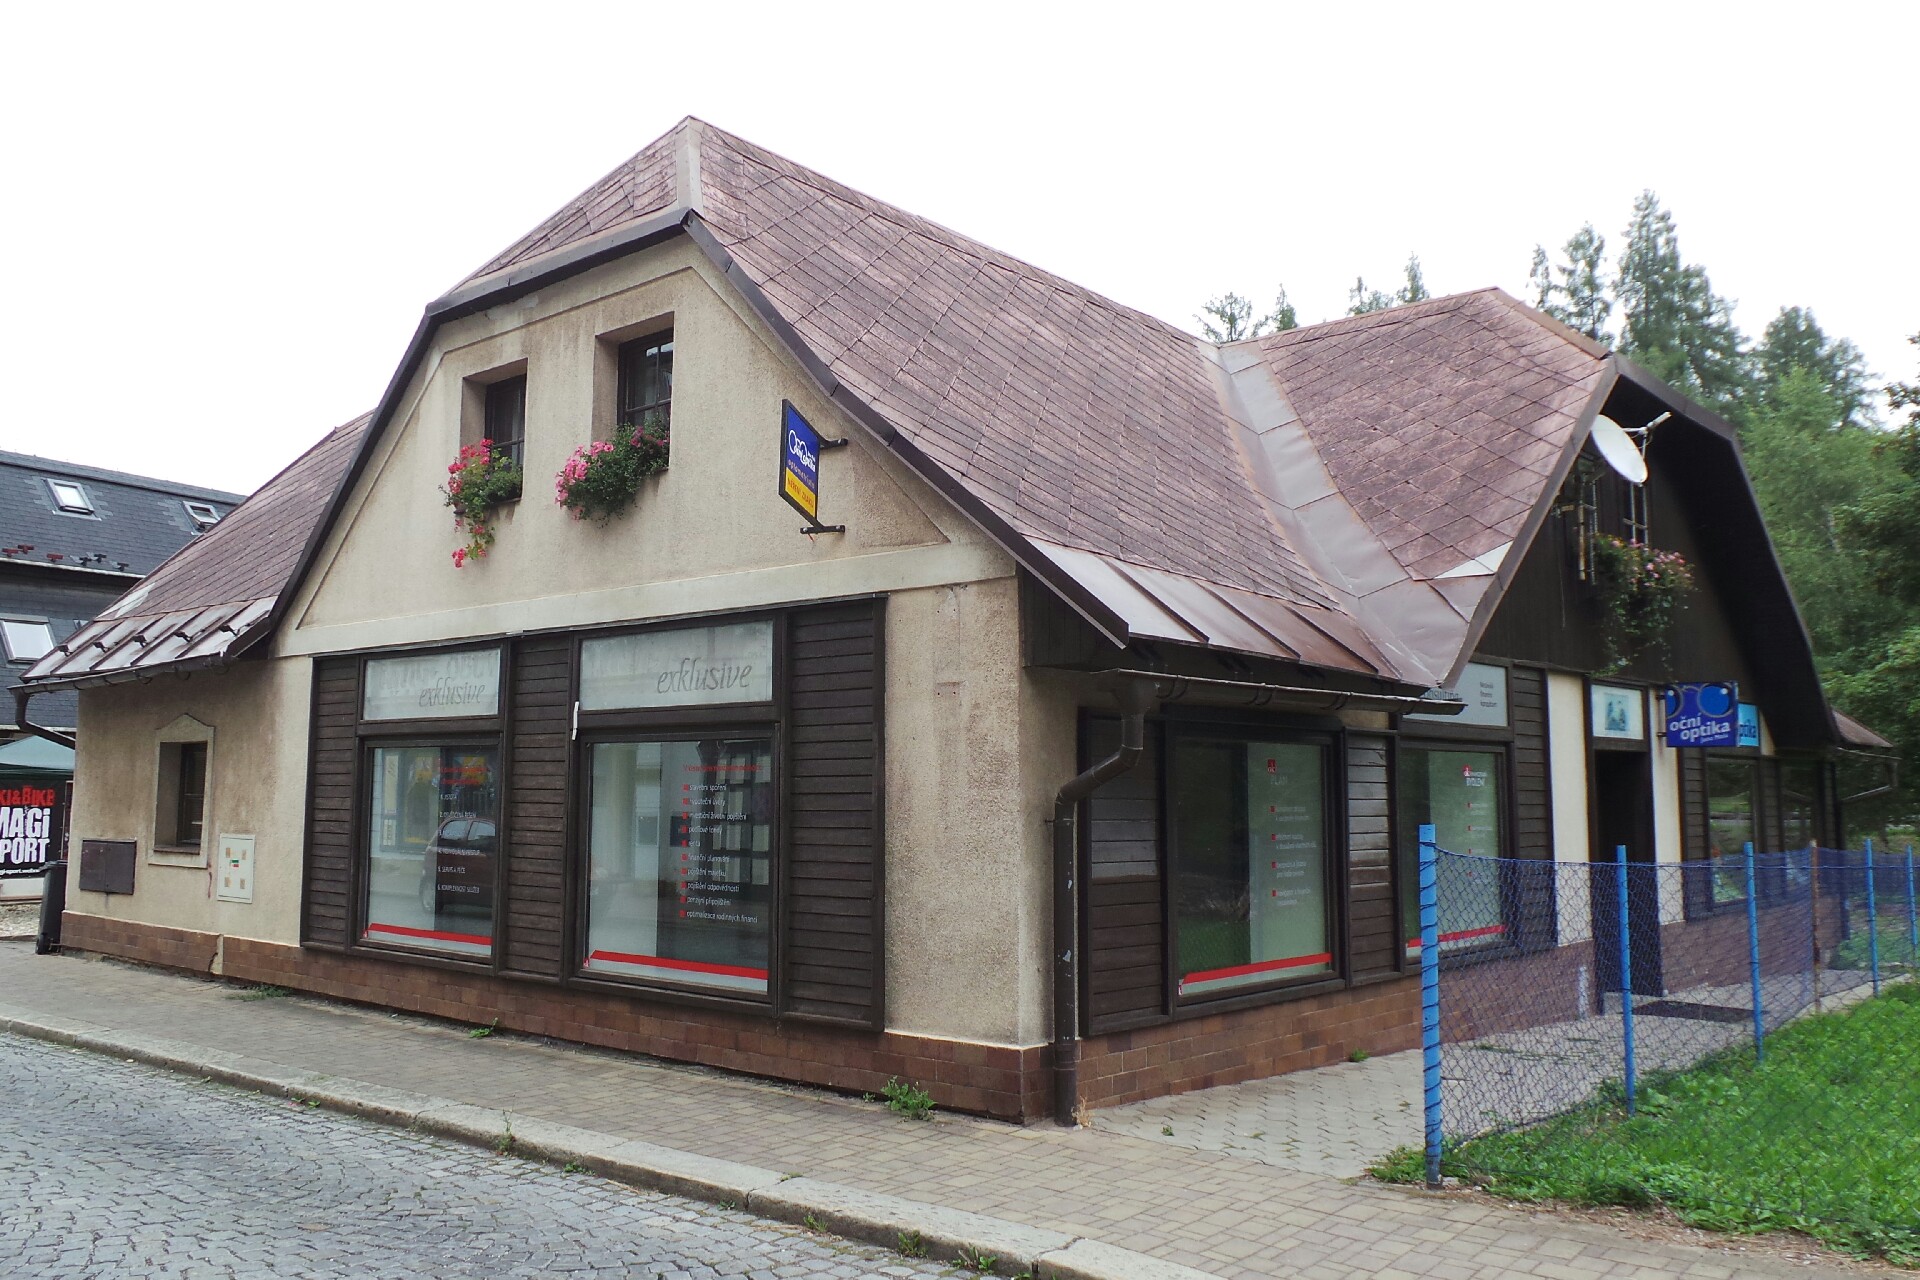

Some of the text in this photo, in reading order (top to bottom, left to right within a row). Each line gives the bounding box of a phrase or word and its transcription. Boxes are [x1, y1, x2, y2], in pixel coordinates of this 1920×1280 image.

[657, 656, 752, 694] exklusive
[418, 676, 486, 708] exklusive
[1670, 712, 1702, 731] oční
[1680, 721, 1731, 743] optika
